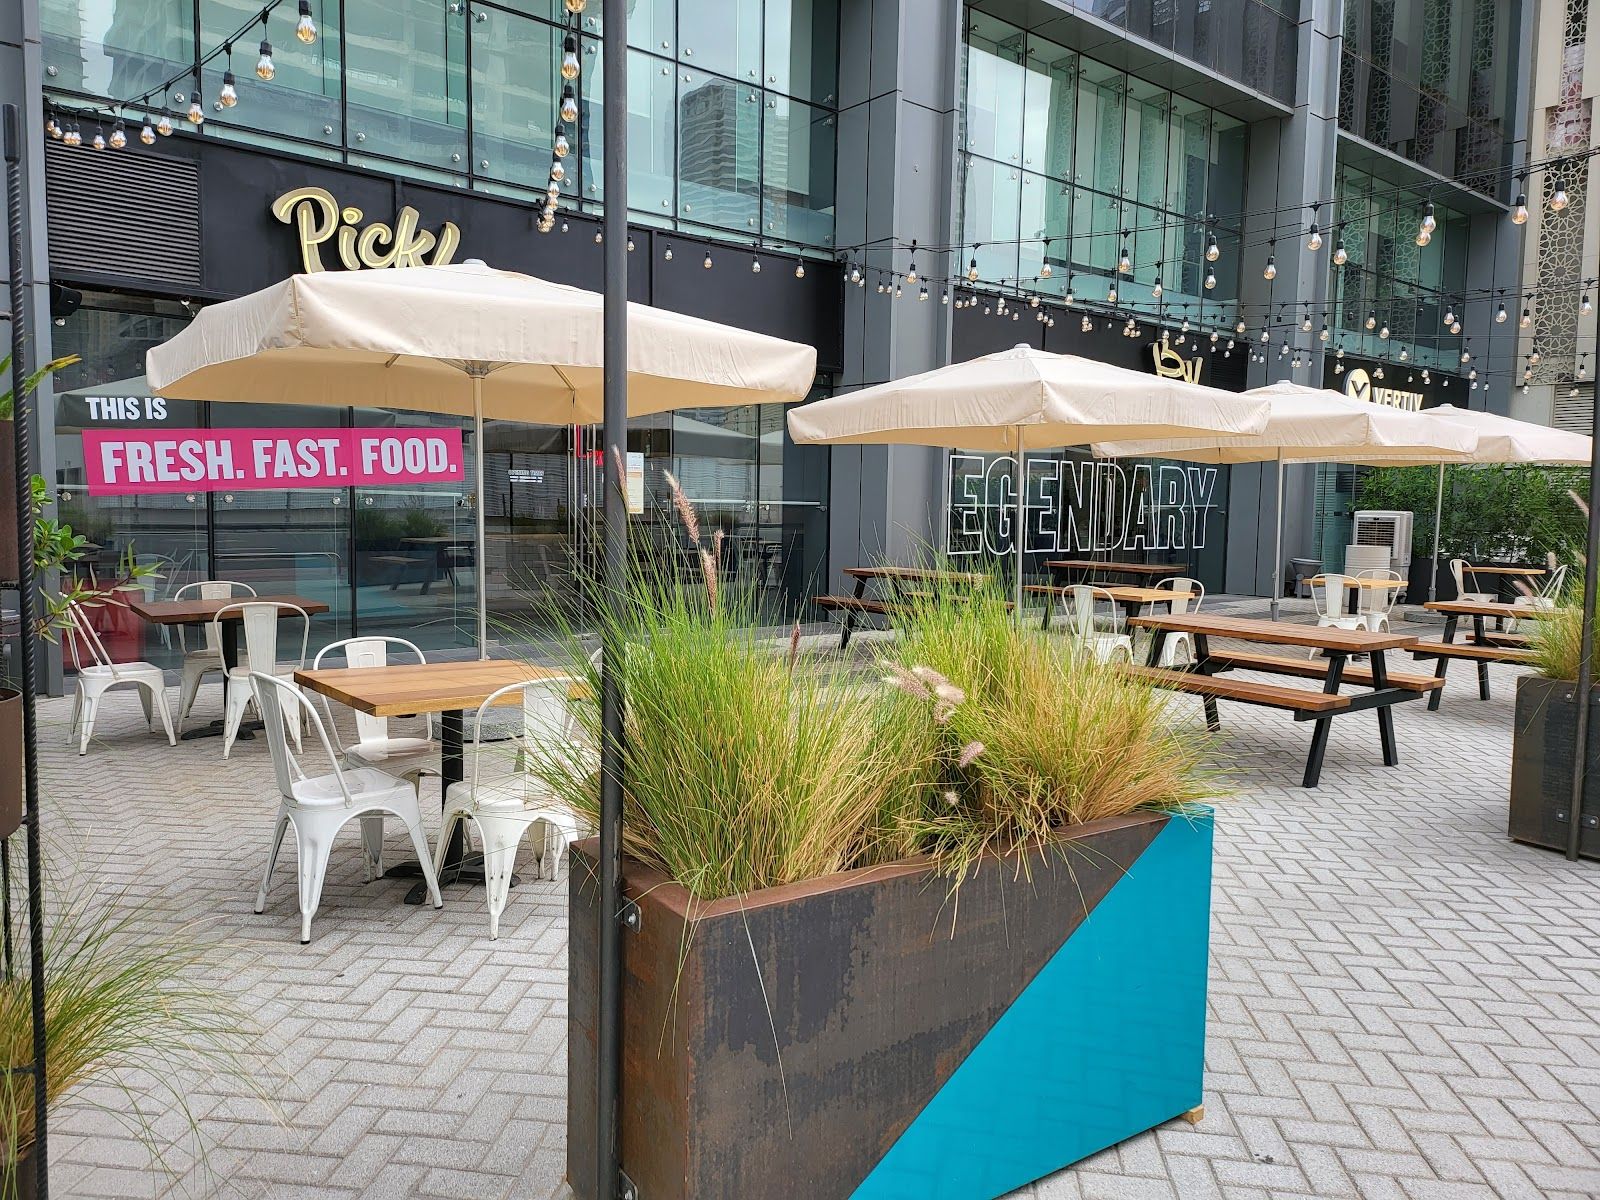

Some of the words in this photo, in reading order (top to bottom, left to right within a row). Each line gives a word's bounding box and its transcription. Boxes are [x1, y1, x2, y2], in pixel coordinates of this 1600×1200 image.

[85, 397, 141, 420] THIS
[145, 397, 168, 420] IS
[1371, 386, 1425, 413] VERTIV
[100, 439, 245, 484] FRESH.
[252, 438, 348, 479] FAST.
[360, 437, 457, 475] FOOD.
[947, 455, 1218, 555] EGENDARY
